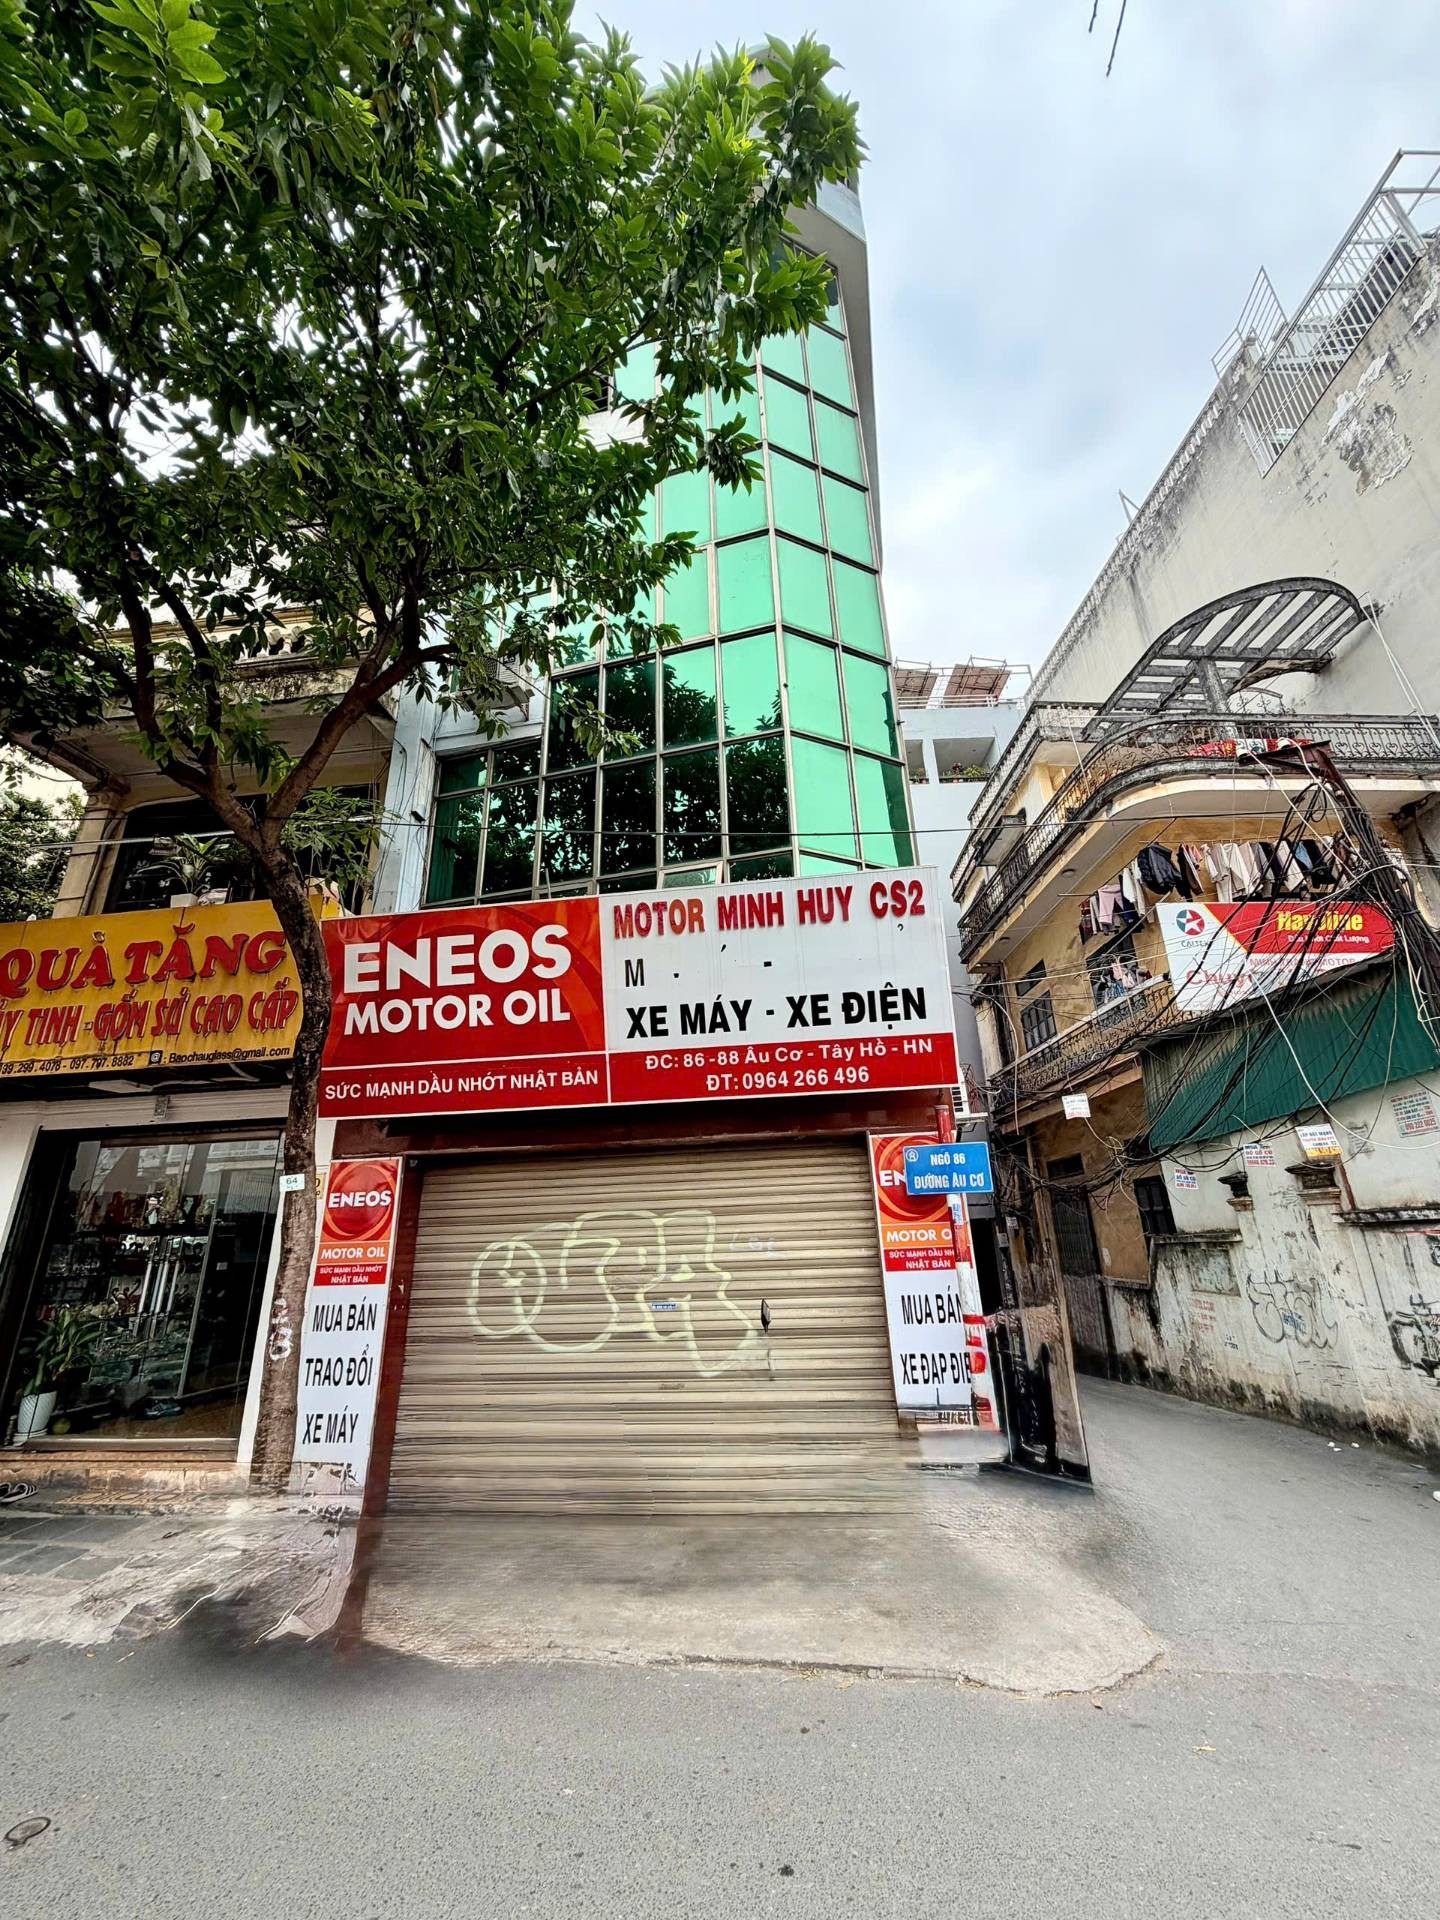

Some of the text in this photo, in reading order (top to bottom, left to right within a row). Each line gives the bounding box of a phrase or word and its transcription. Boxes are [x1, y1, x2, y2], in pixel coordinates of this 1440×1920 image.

[614, 880, 926, 940] MOTOR MINH HUY CS2
[0, 930, 115, 999] QUẢ
[344, 924, 571, 994] ENEOS
[24, 1004, 85, 1046] TINH
[94, 989, 151, 1041] GỐM
[190, 993, 243, 1038] CAO
[248, 976, 299, 1034] CẤP
[343, 988, 571, 1036] MOTOR OIL
[626, 1006, 669, 1040] XE
[679, 994, 752, 1035] MÁY
[786, 994, 832, 1029] XE
[841, 982, 927, 1031] ĐIỆN
[645, 1054, 679, 1070] ĐC:
[683, 1052, 705, 1068] 86
[744, 1046, 770, 1064] Âu
[774, 1047, 804, 1062] Cơ
[818, 1044, 855, 1061] Tây
[859, 1040, 887, 1057] Hồ
[903, 1038, 933, 1055] HN
[324, 1066, 599, 1100] SỨC MẠNH DẦU NHỚT NHẬT BẢN
[706, 1066, 870, 1091] ĐT: 0964 266 496
[930, 1151, 966, 1166] NGÕ 86
[914, 1172, 950, 1189] ĐƯỜNG
[952, 1171, 967, 1188] ÂU
[969, 1172, 985, 1188] CƠ
[328, 1190, 392, 1208] ENEOS
[886, 1229, 938, 1242] MOTOR
[320, 1246, 386, 1260] MOTOR OIL
[320, 1266, 333, 1274] SỨC
[352, 1264, 365, 1273] DẦU
[365, 1264, 383, 1273] NHỚT
[889, 1250, 906, 1258] SỨC
[906, 1250, 927, 1260] MẠNH
[928, 1248, 944, 1257] DẦU
[906, 1258, 952, 1271] NHẬT BẢN
[330, 1273, 369, 1285] NHẬT BẢN
[312, 1296, 378, 1332] MUA BÁN
[901, 1294, 934, 1325] MUA
[304, 1343, 374, 1386] TRAO ĐỔI
[900, 1353, 920, 1385] XE
[302, 1405, 359, 1444] XE MÁY
